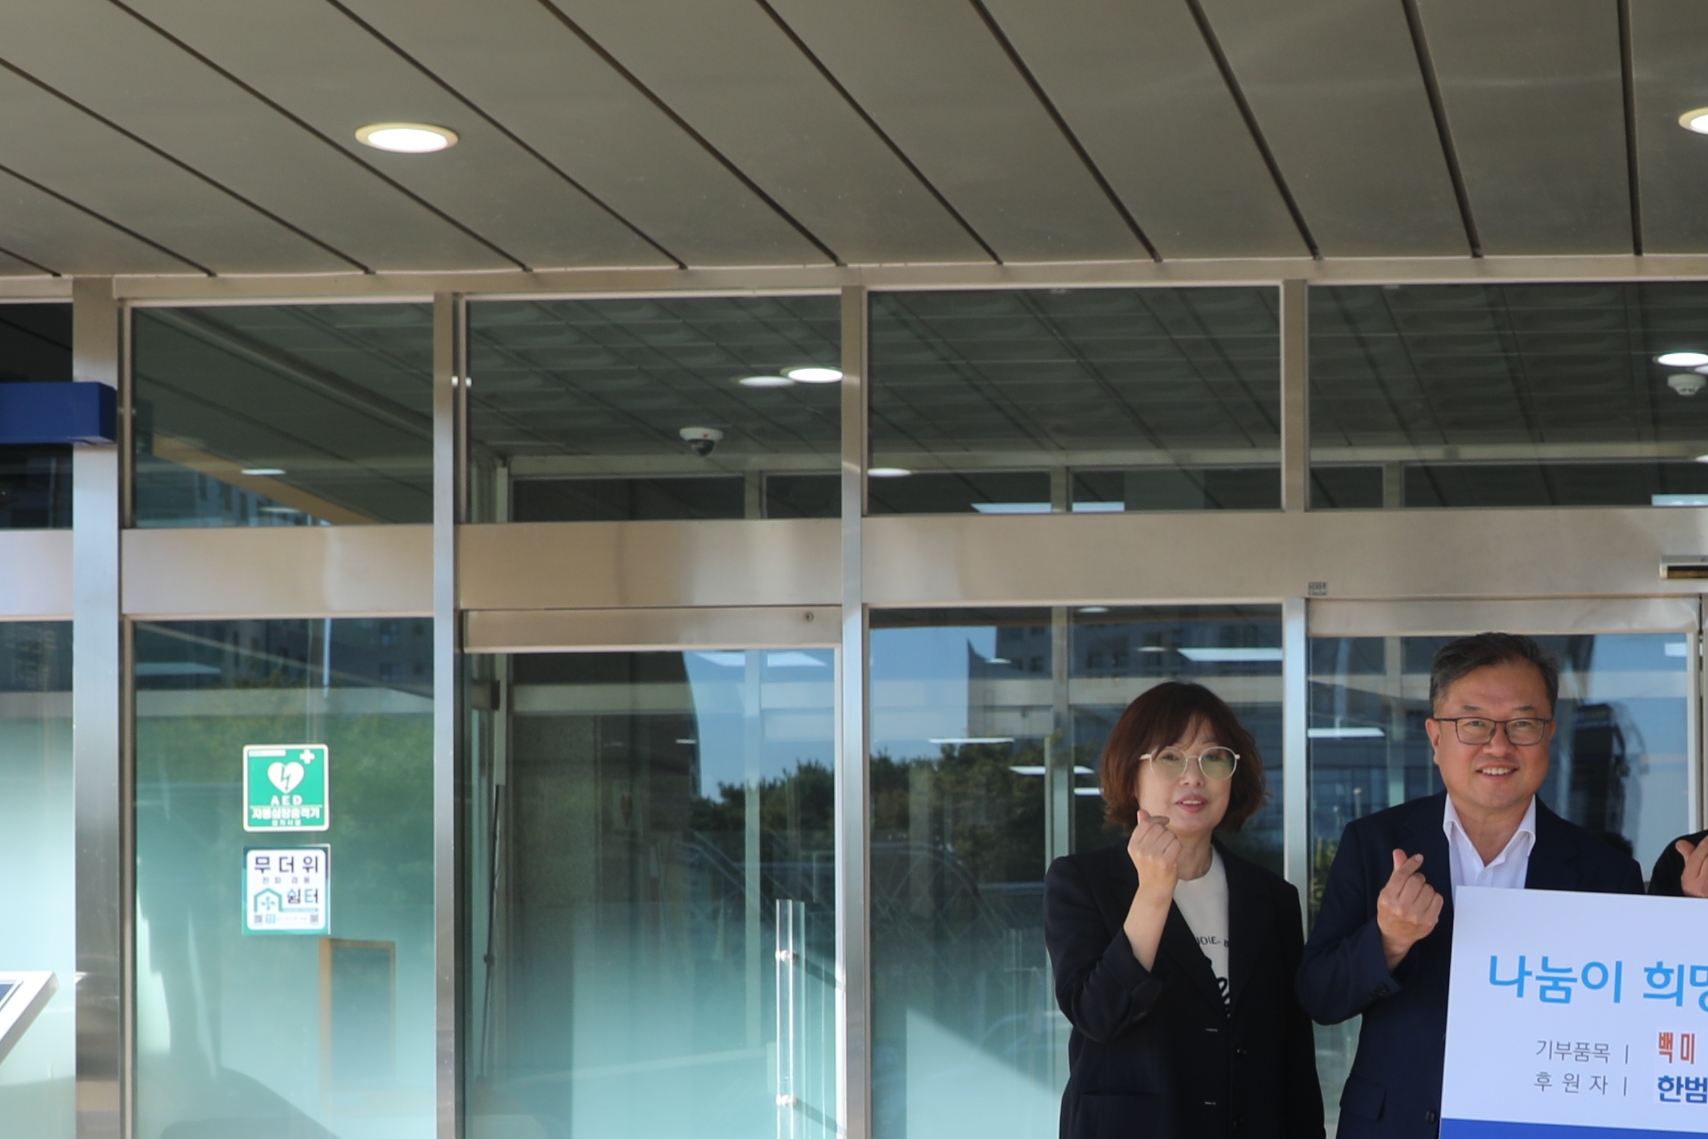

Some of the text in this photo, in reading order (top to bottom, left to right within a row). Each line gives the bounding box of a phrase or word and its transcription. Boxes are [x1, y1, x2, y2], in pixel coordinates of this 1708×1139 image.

[270, 794, 303, 806] AED
[254, 855, 319, 875] 무더위
[286, 888, 319, 905] 쉼터
[1488, 954, 1624, 1005] 나눔이
[1535, 1038, 1612, 1064] 기부품목
[1657, 1031, 1697, 1065] 백미
[1533, 1072, 1609, 1097] 후원자
